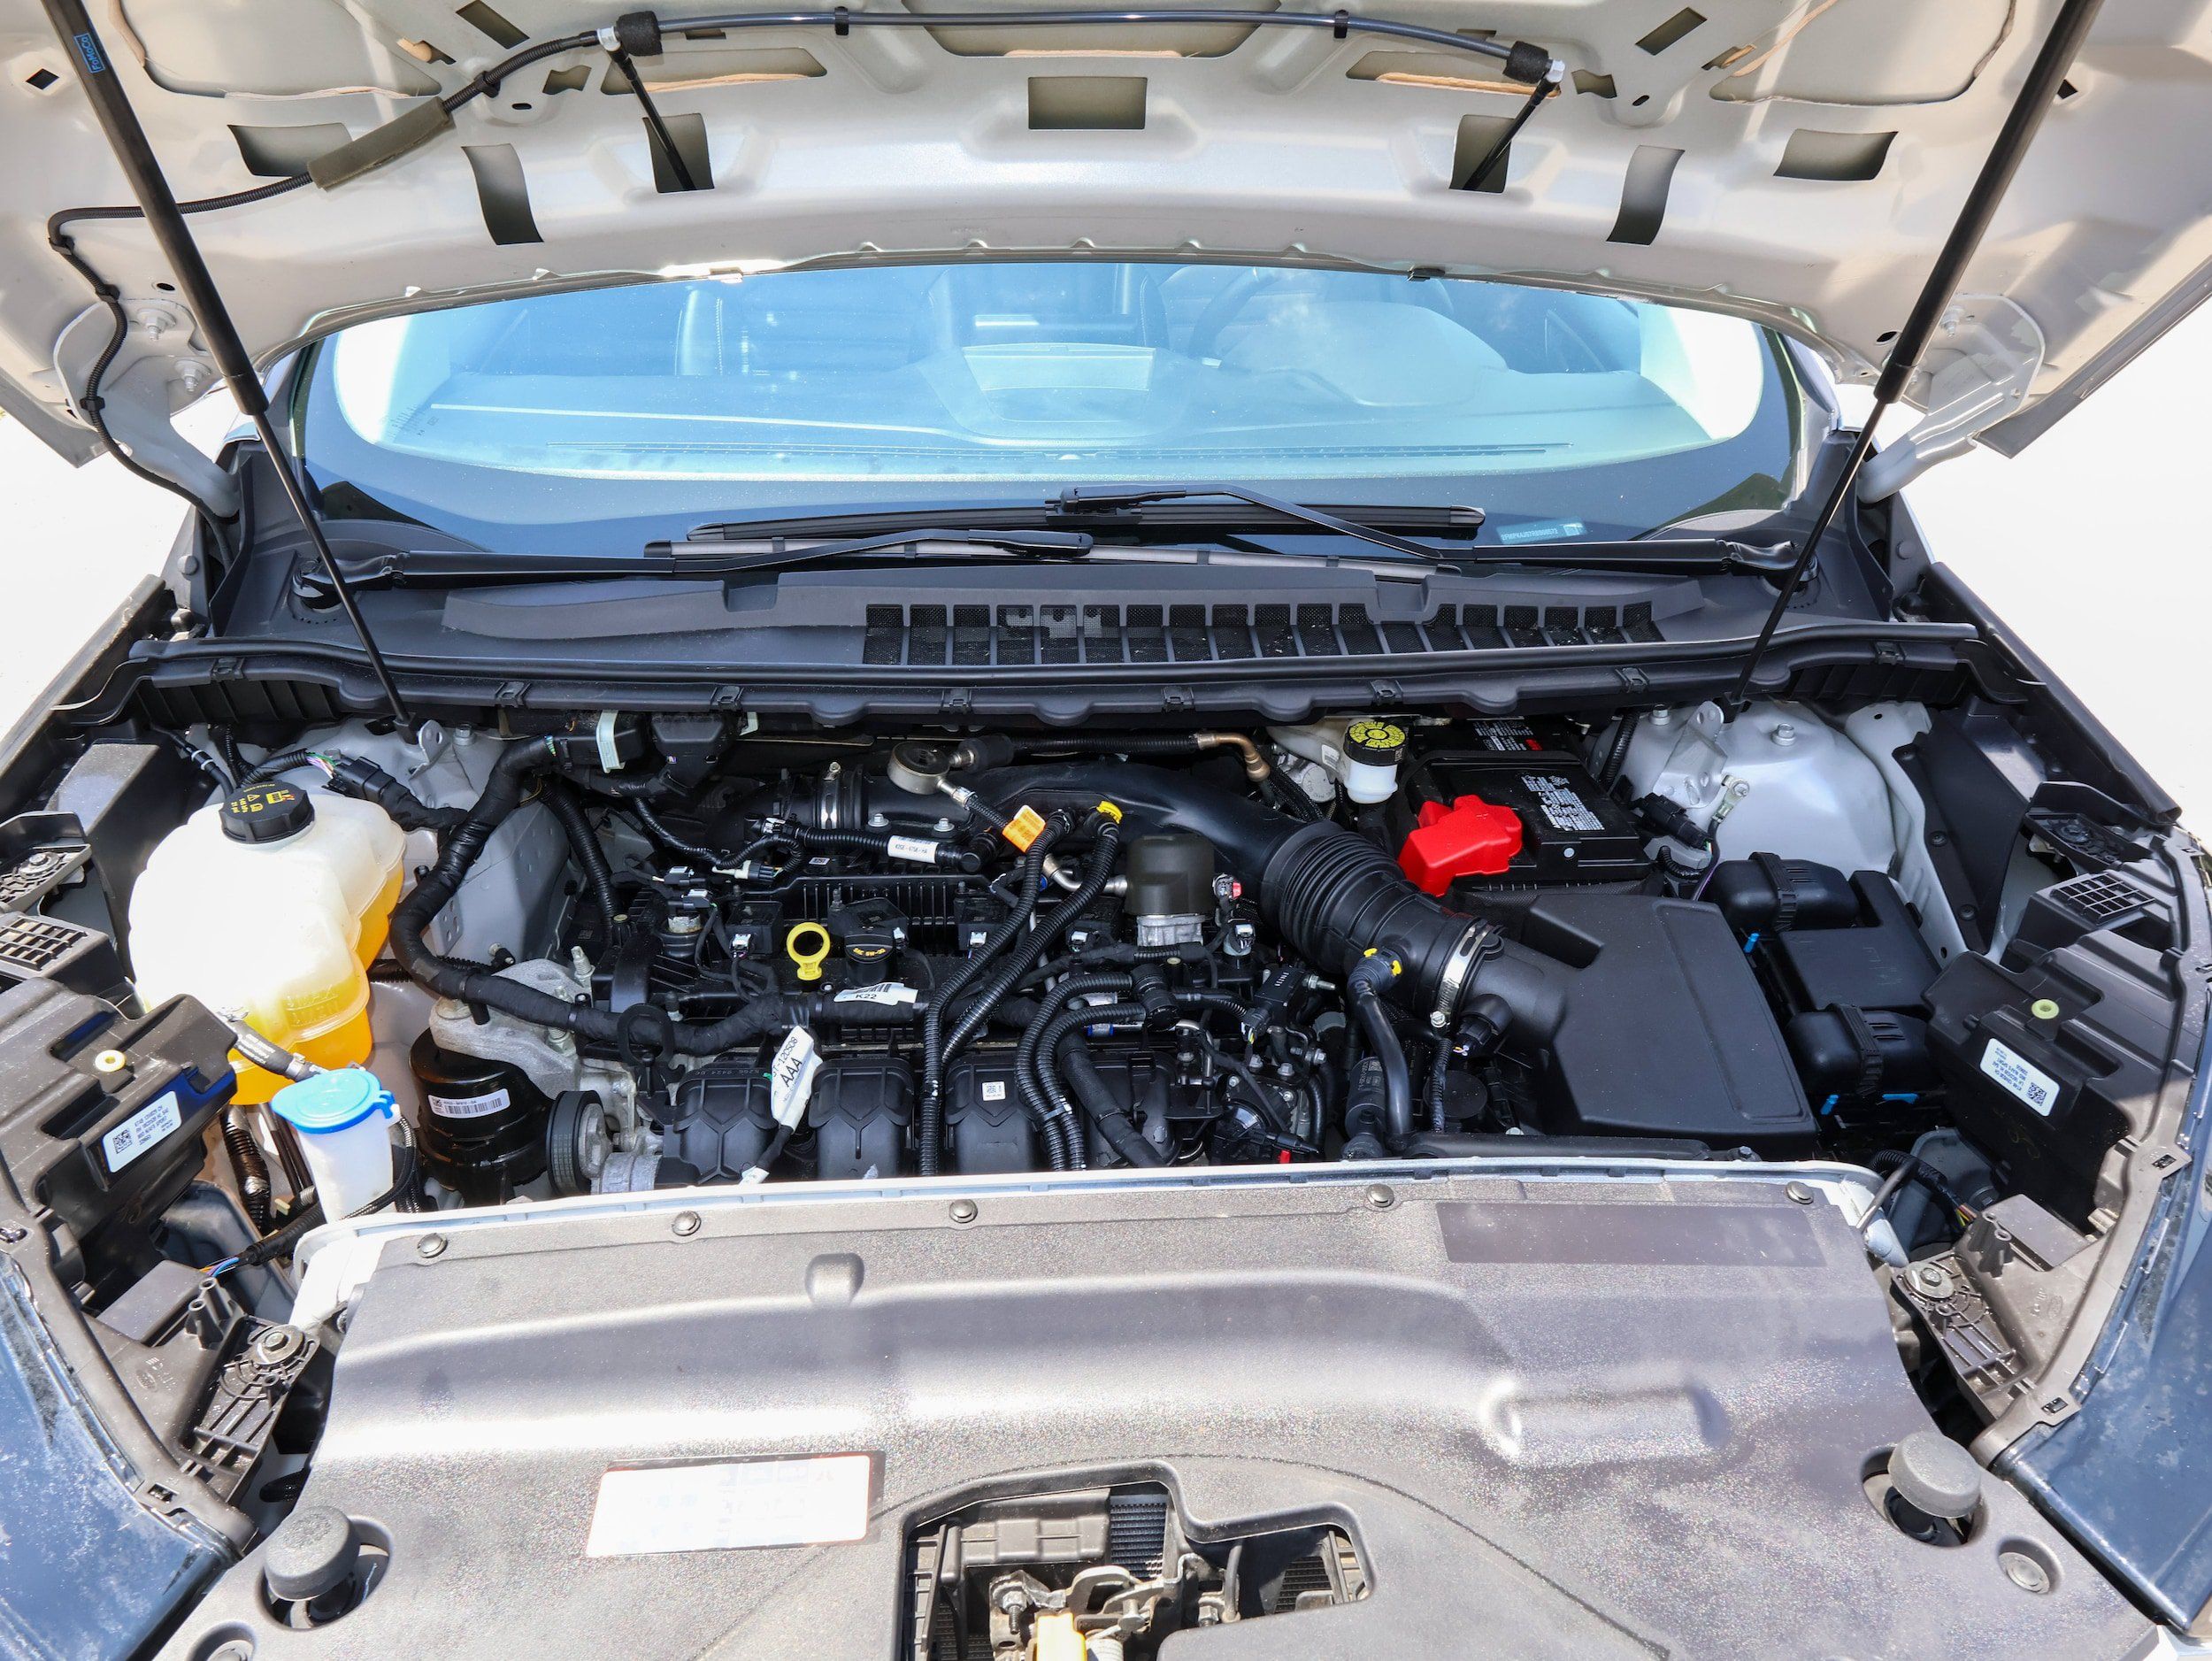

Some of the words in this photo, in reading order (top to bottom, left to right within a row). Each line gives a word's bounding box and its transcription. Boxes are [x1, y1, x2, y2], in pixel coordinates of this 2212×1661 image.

[81, 36, 101, 70] FoMoCo
[853, 947, 864, 956] SAE
[781, 1057, 803, 1088] AAA
